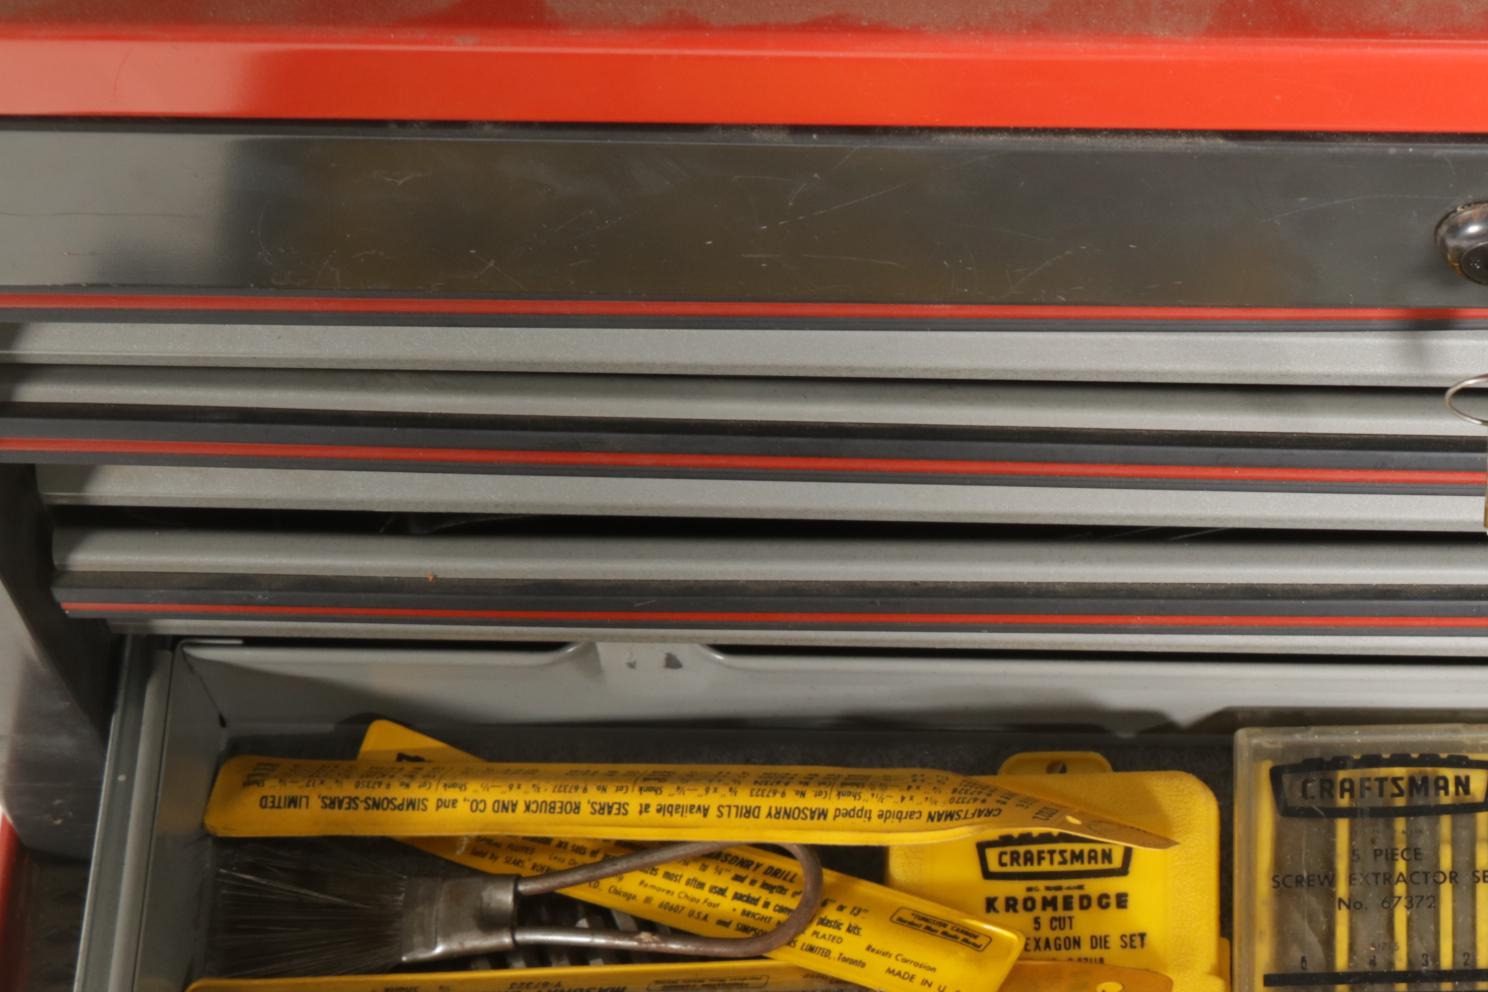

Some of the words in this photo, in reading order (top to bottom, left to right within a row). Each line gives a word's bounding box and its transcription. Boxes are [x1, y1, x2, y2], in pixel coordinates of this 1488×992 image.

[1300, 775, 1470, 800] CRAFTSMAN
[257, 794, 309, 810] LIMITED
[435, 797, 458, 811] and
[491, 798, 518, 813] AND
[522, 799, 581, 815] ROEBUCK
[586, 799, 629, 816] SEARS,
[636, 803, 651, 816] at
[654, 802, 711, 818] Available
[715, 804, 761, 818] DRILLS
[764, 805, 828, 820] MASONRY
[832, 806, 872, 821] tipped
[876, 808, 922, 823] carbide
[926, 806, 1002, 824] CRAFTSMAN
[997, 847, 1113, 867] CRAFTSMAN
[1351, 848, 1359, 862] 5
[1373, 847, 1422, 861] PIECE
[1272, 872, 1334, 888] SCREW
[1348, 869, 1458, 887] EXTRACTOR
[985, 892, 1128, 913] KROMEDGE
[1338, 897, 1368, 911] No.
[1380, 894, 1436, 910] 67372
[1033, 916, 1040, 931] 5
[1049, 915, 1074, 930] CUT
[811, 929, 844, 945] PLATED
[1024, 935, 1080, 952] EXAGON
[1090, 935, 1110, 949] DIE
[1120, 932, 1146, 948] SET
[884, 965, 916, 984] MADE
[919, 977, 933, 989] IN
